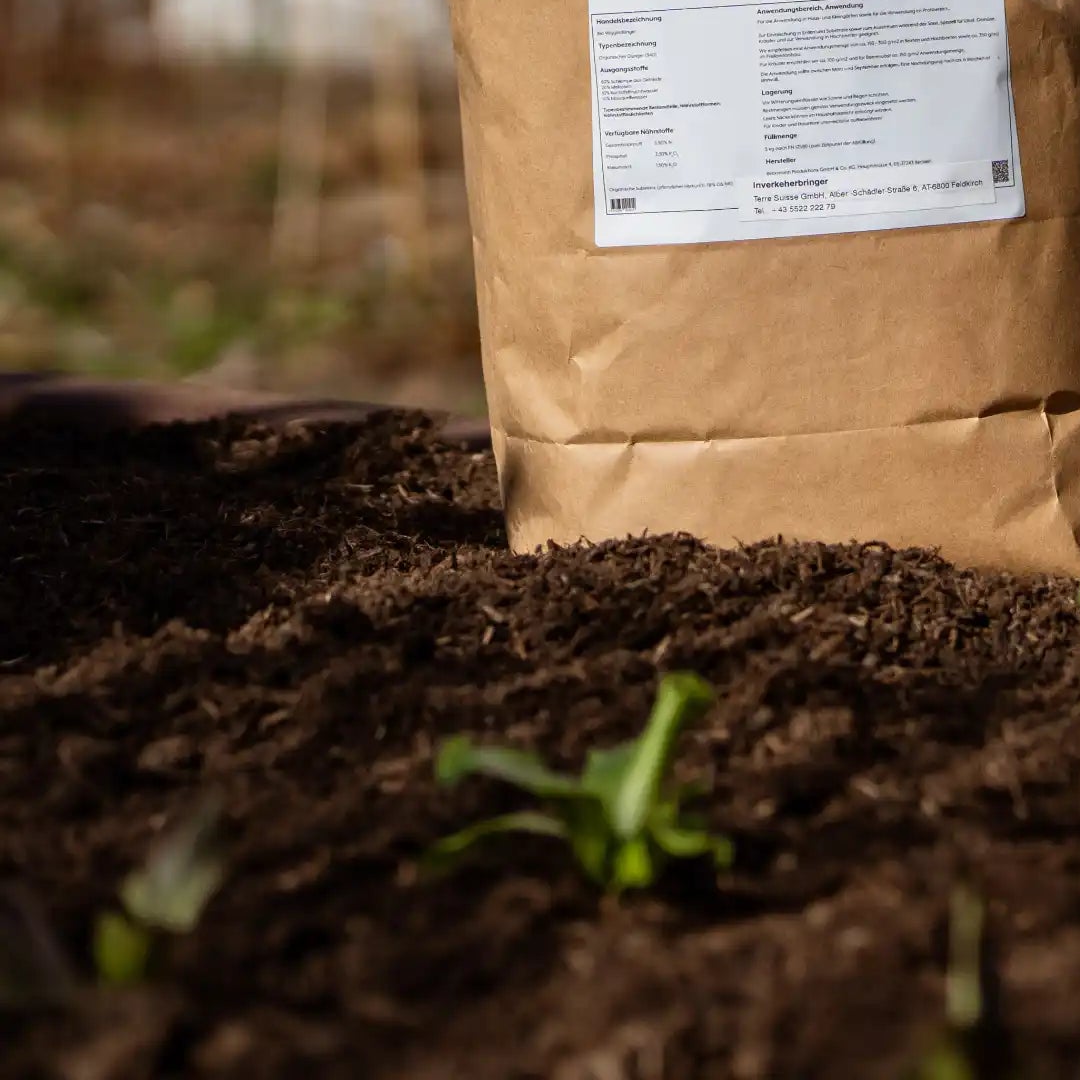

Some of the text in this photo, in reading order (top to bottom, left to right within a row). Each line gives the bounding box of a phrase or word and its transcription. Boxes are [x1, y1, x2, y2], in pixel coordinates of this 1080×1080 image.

[825, 2, 864, 10] Anwendung
[596, 16, 662, 25] Handelsbezeichnung
[761, 88, 793, 96] Lagerung
[922, 181, 950, 191] AT-6800
[951, 179, 984, 189] Feldkirch
[789, 205, 808, 213] 5522
